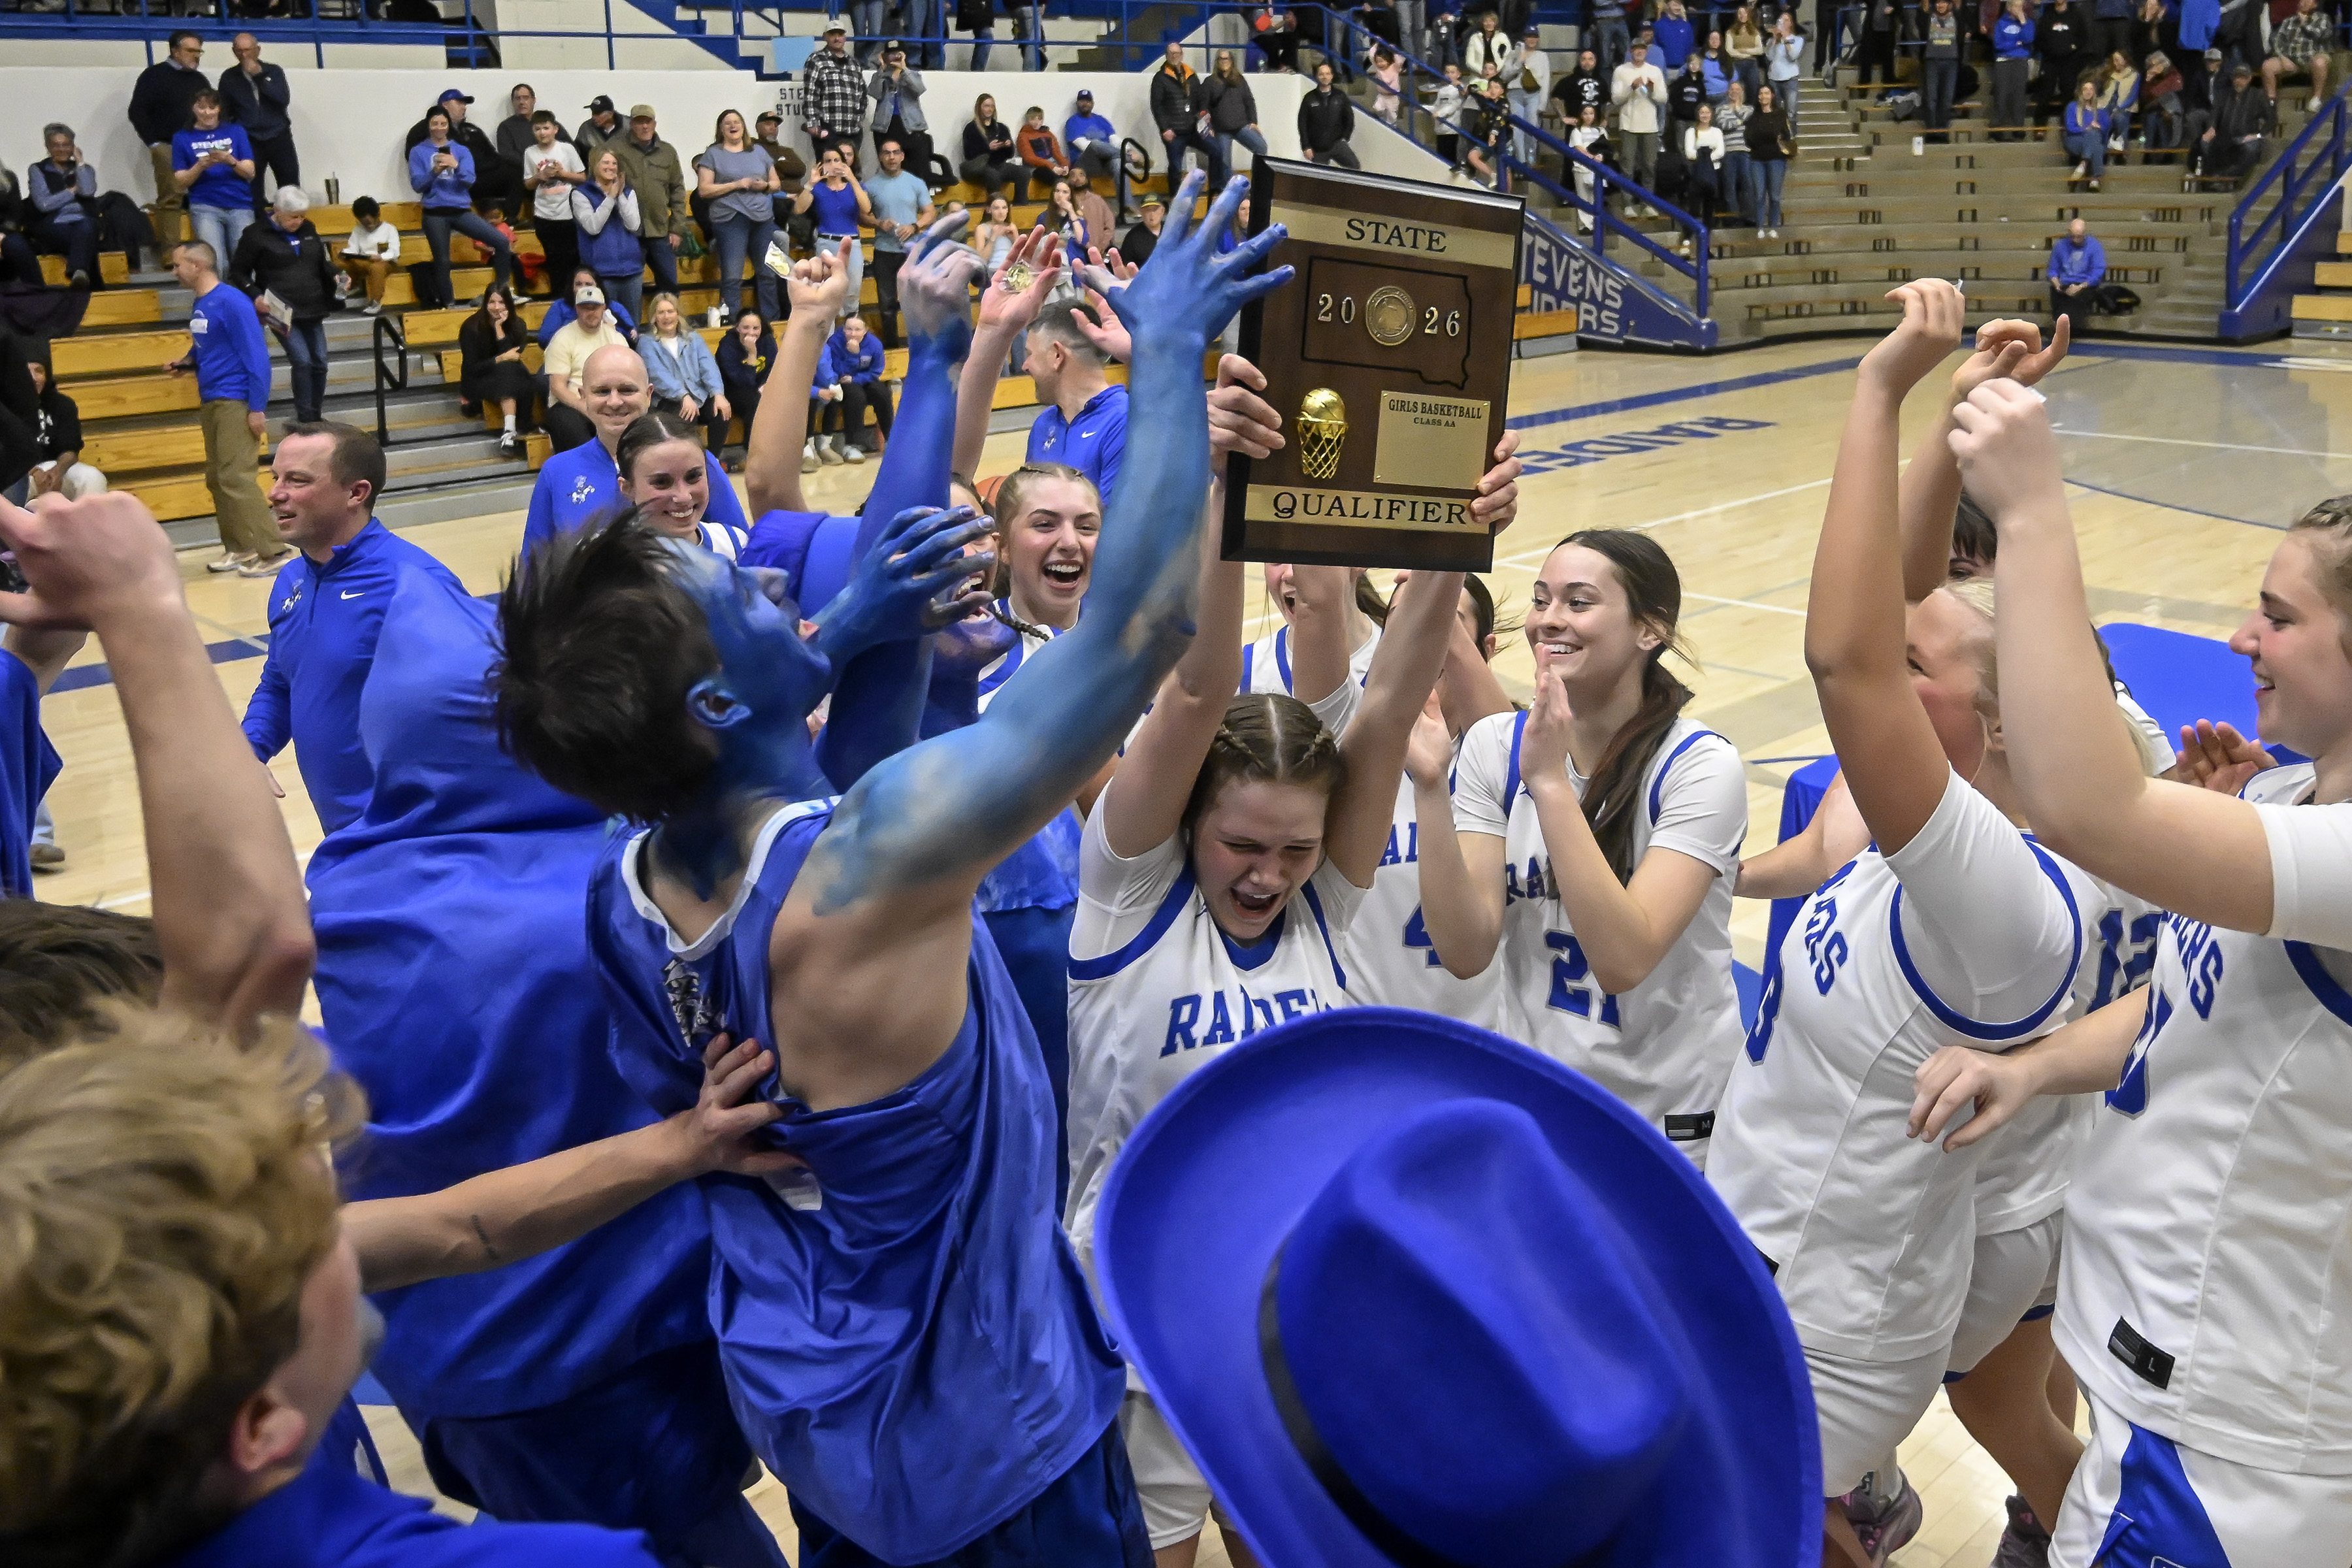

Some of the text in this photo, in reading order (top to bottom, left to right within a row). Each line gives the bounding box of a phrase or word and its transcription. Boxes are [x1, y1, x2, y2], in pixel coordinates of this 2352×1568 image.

[776, 103, 803, 116] STU
[1345, 218, 1447, 253] STATE
[1318, 294, 1356, 324] 20
[1424, 306, 1460, 337] 26
[1388, 399, 1482, 419] GIRLS BASKETBALL
[1413, 417, 1442, 427] CLASS
[1512, 416, 1776, 476] RAIDE
[1273, 491, 1467, 525] QUALIFIER
[1701, 1120, 1710, 1130] M
[2148, 1357, 2155, 1372] L
